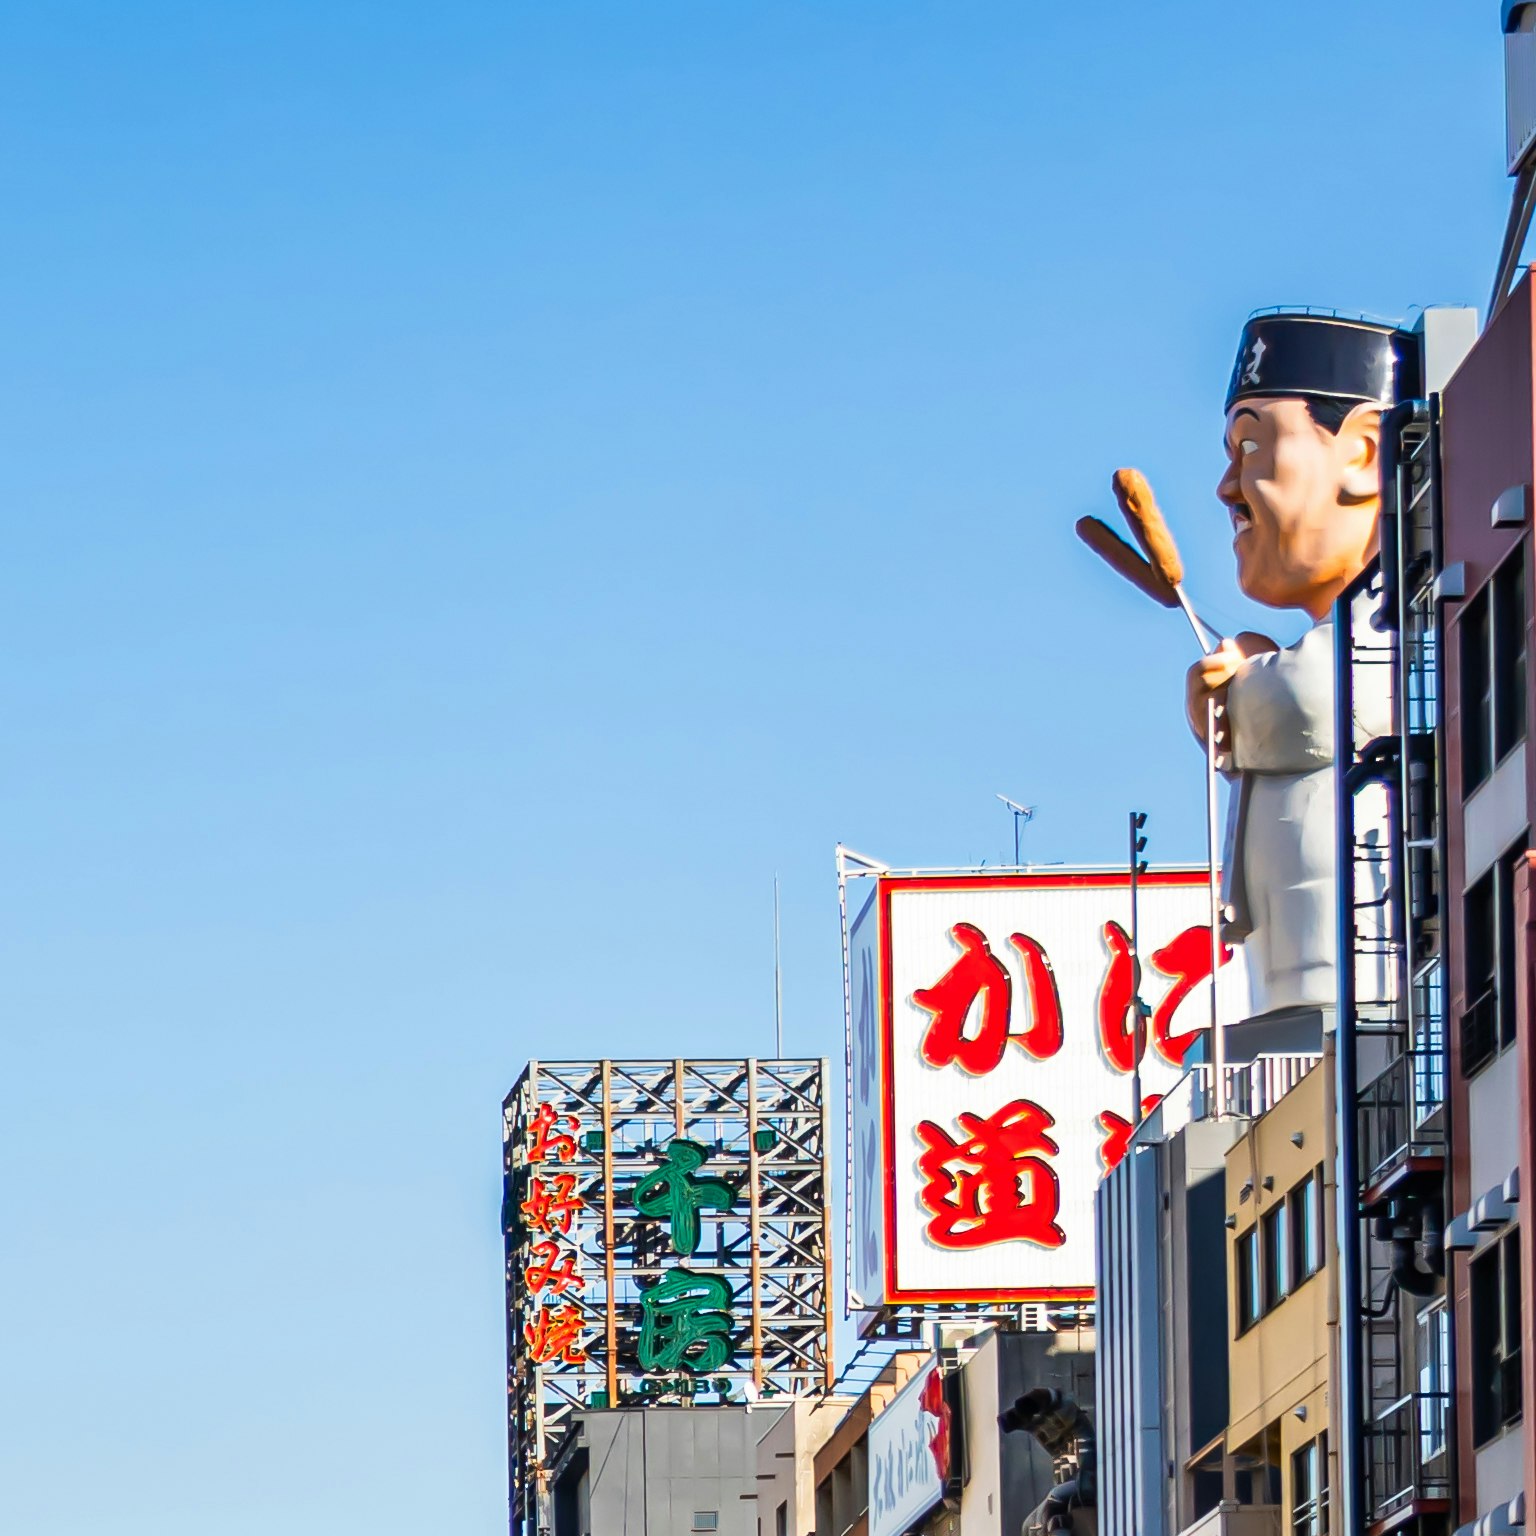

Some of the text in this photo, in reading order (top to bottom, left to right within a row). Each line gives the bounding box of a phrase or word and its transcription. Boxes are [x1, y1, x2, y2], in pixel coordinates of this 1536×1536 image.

[913, 921, 1233, 1076] かに
[521, 1102, 586, 1364] お好み焼
